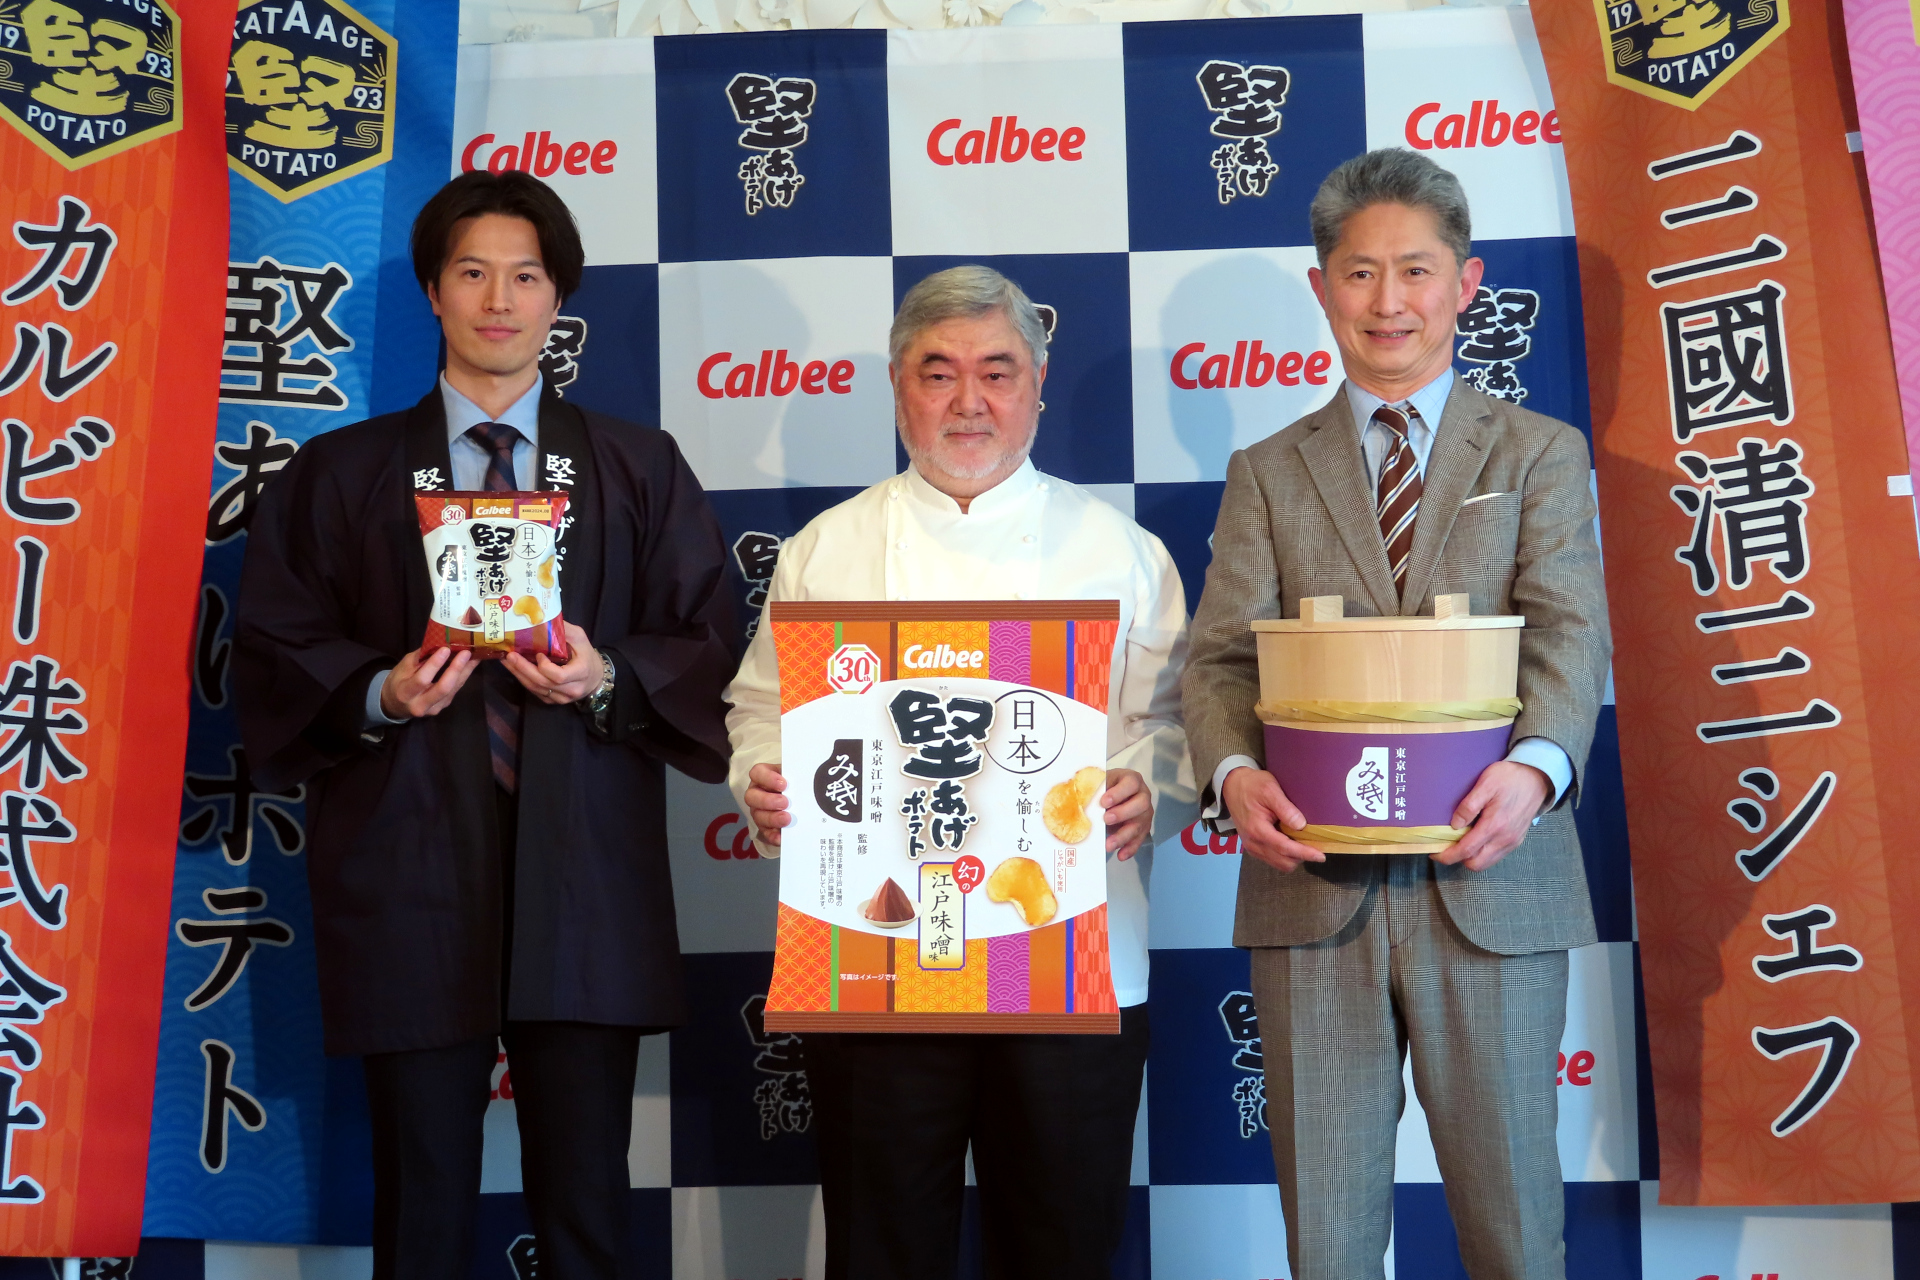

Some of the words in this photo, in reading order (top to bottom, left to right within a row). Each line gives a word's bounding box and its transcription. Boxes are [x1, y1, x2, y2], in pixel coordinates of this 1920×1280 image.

[1611, 3, 1632, 28] 19
[145, 52, 173, 79] 93
[1648, 42, 1736, 84] POTATO
[353, 86, 383, 110] 93
[27, 104, 127, 144] POTATO
[926, 116, 1086, 166] Calbee
[1405, 99, 1563, 150] Calbee
[242, 143, 337, 177] POTATO
[461, 131, 618, 178] Calbee
[696, 349, 855, 399] Calbee
[1170, 340, 1332, 390] Calbee
[475, 506, 512, 516] Calbee
[1646, 130, 1863, 1138] 三國清三シェフ
[903, 644, 984, 669] Calbee
[870, 739, 883, 823] 東京江戸味噌
[1395, 747, 1406, 820] 東京江戸味噌
[857, 833, 868, 855] 監修
[1066, 849, 1075, 866] 国産
[839, 973, 901, 982] 写真はイメージです。
